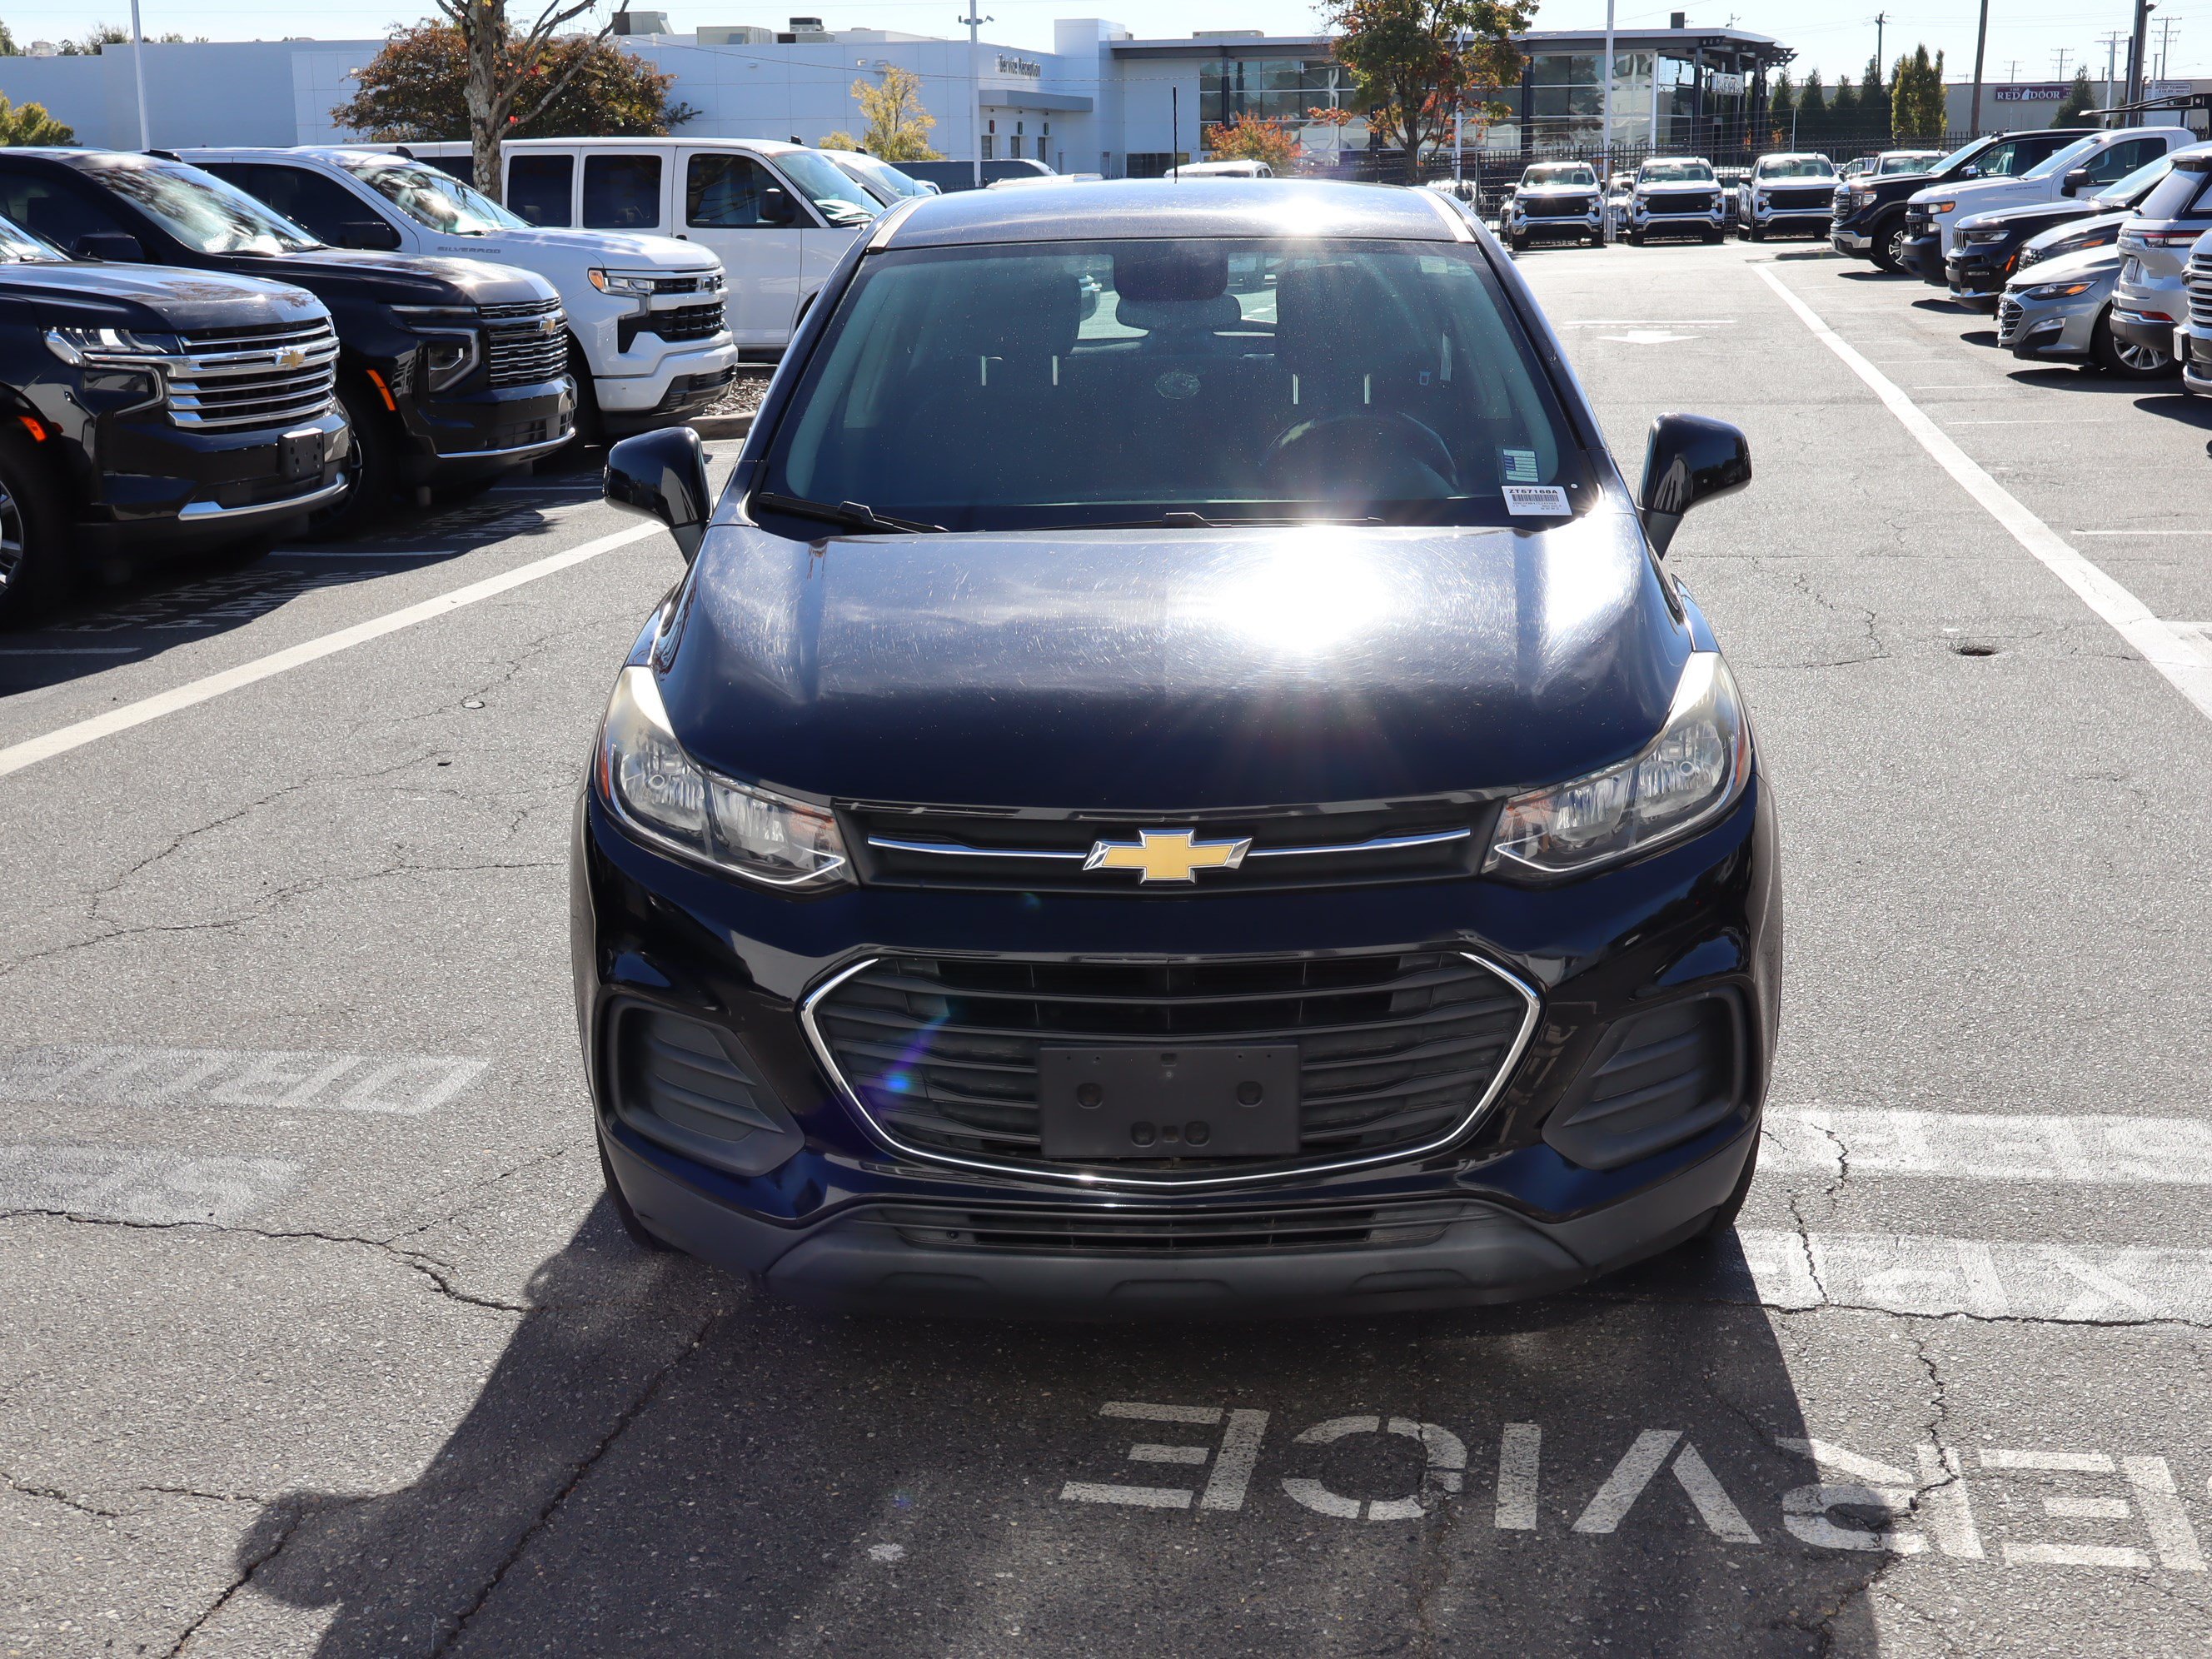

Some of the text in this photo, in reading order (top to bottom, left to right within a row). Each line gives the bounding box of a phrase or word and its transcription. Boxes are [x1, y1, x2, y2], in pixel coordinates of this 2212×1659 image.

[1997, 91, 2020, 100] RED
[2030, 90, 2060, 100] DOOR
[436, 246, 501, 254] SILVERADO
[1058, 1400, 2212, 1573] ERVICE
